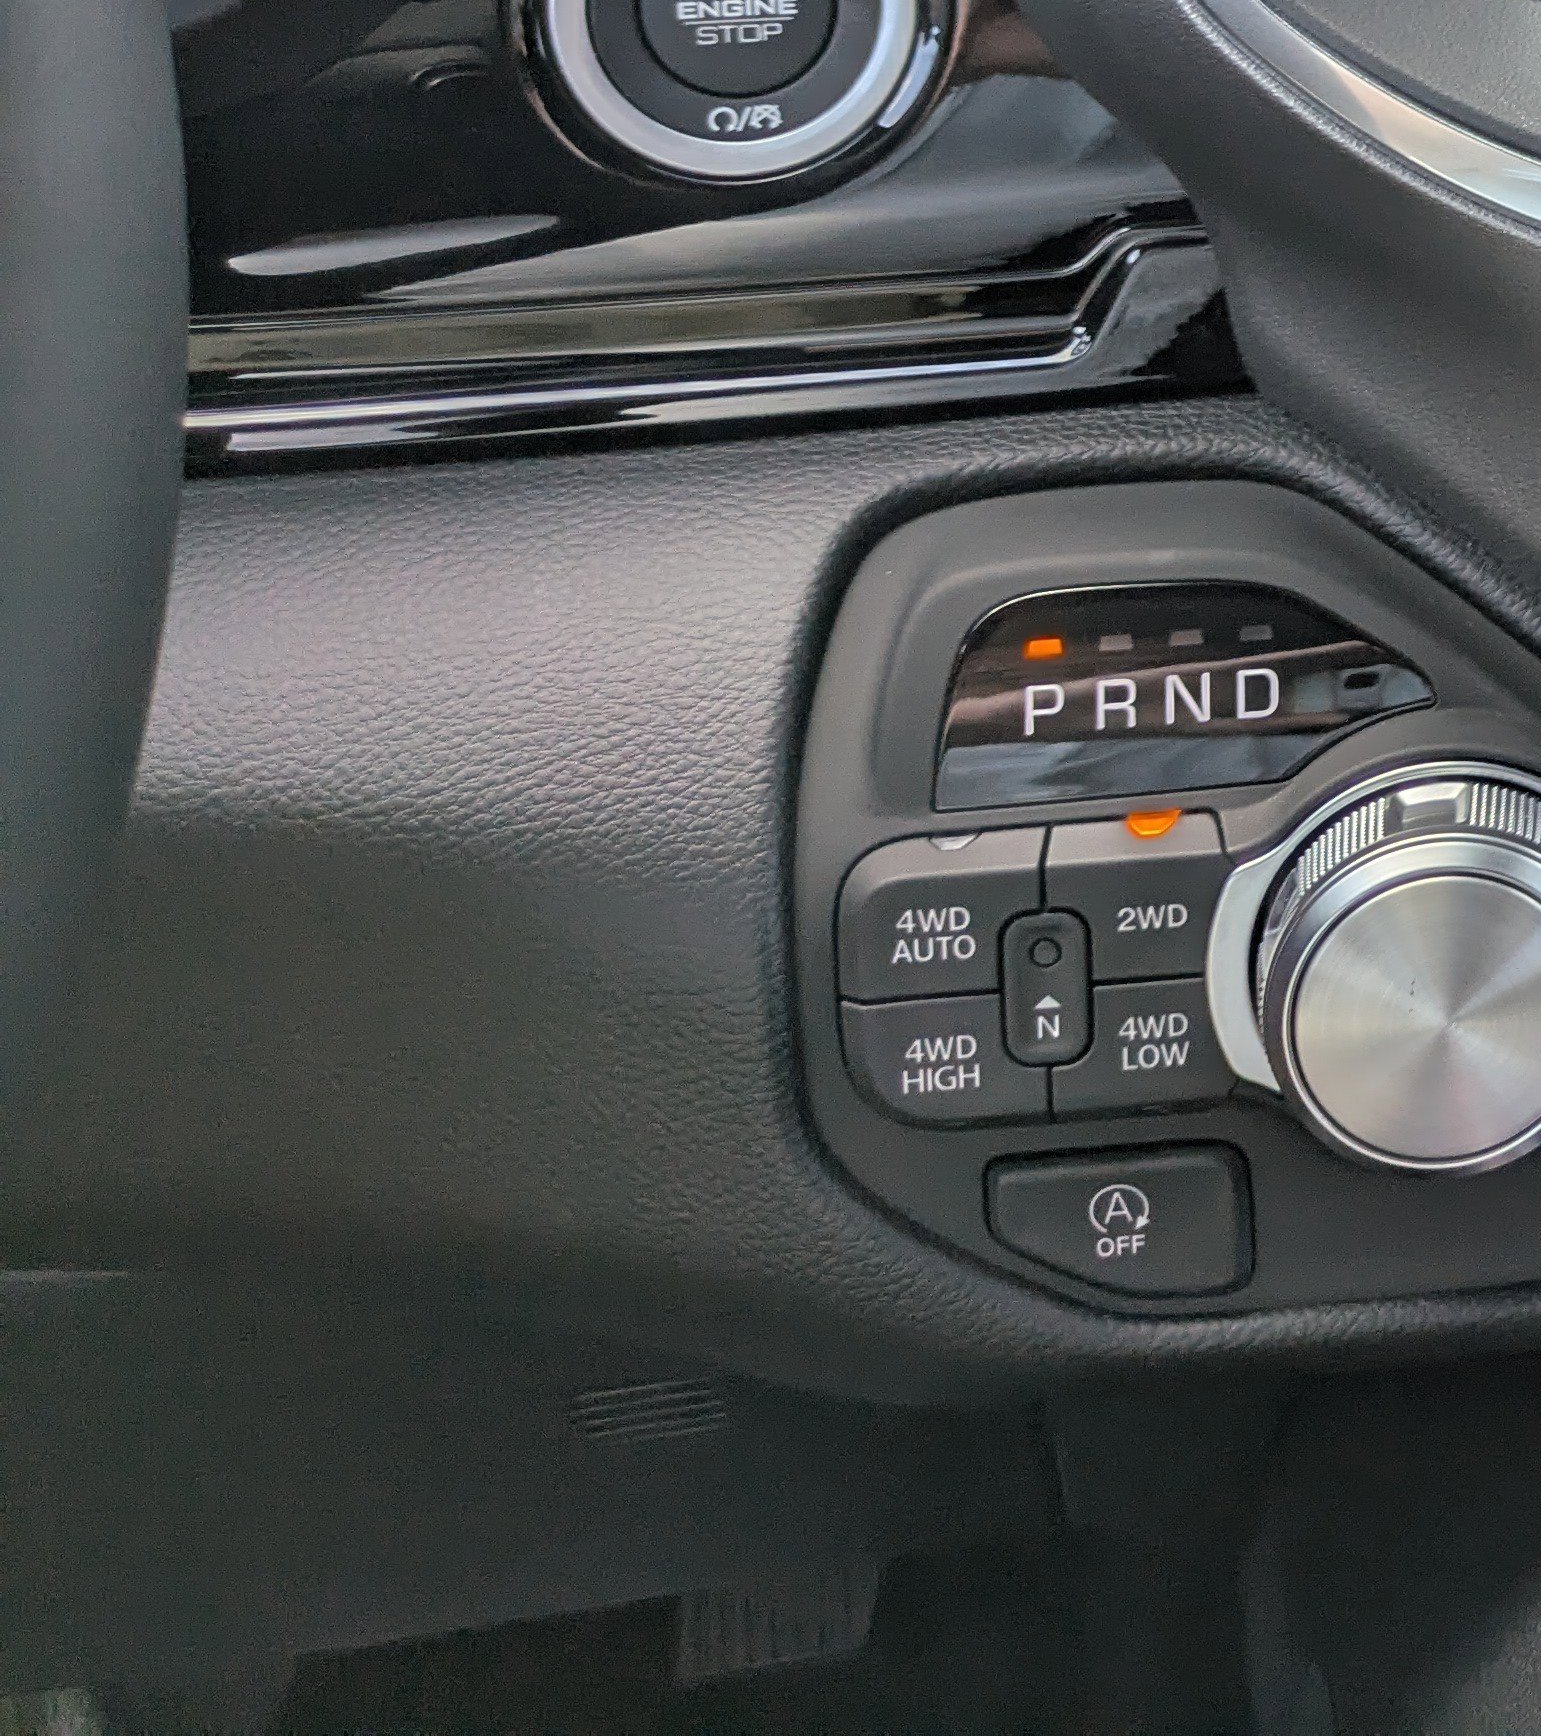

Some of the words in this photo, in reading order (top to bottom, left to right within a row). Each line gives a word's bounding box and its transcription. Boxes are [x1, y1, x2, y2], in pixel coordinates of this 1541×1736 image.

[695, 22, 783, 47] STOP
[896, 906, 971, 934] 4WD
[1117, 903, 1188, 932] 2WD
[892, 934, 977, 964] AUTO
[1037, 1014, 1060, 1039] N
[1118, 1012, 1189, 1041] 4WD
[904, 1034, 977, 1062] 4WD
[1121, 1040, 1190, 1071] LOW
[902, 1064, 981, 1095] HIGH
[1096, 1234, 1146, 1258] OFF
